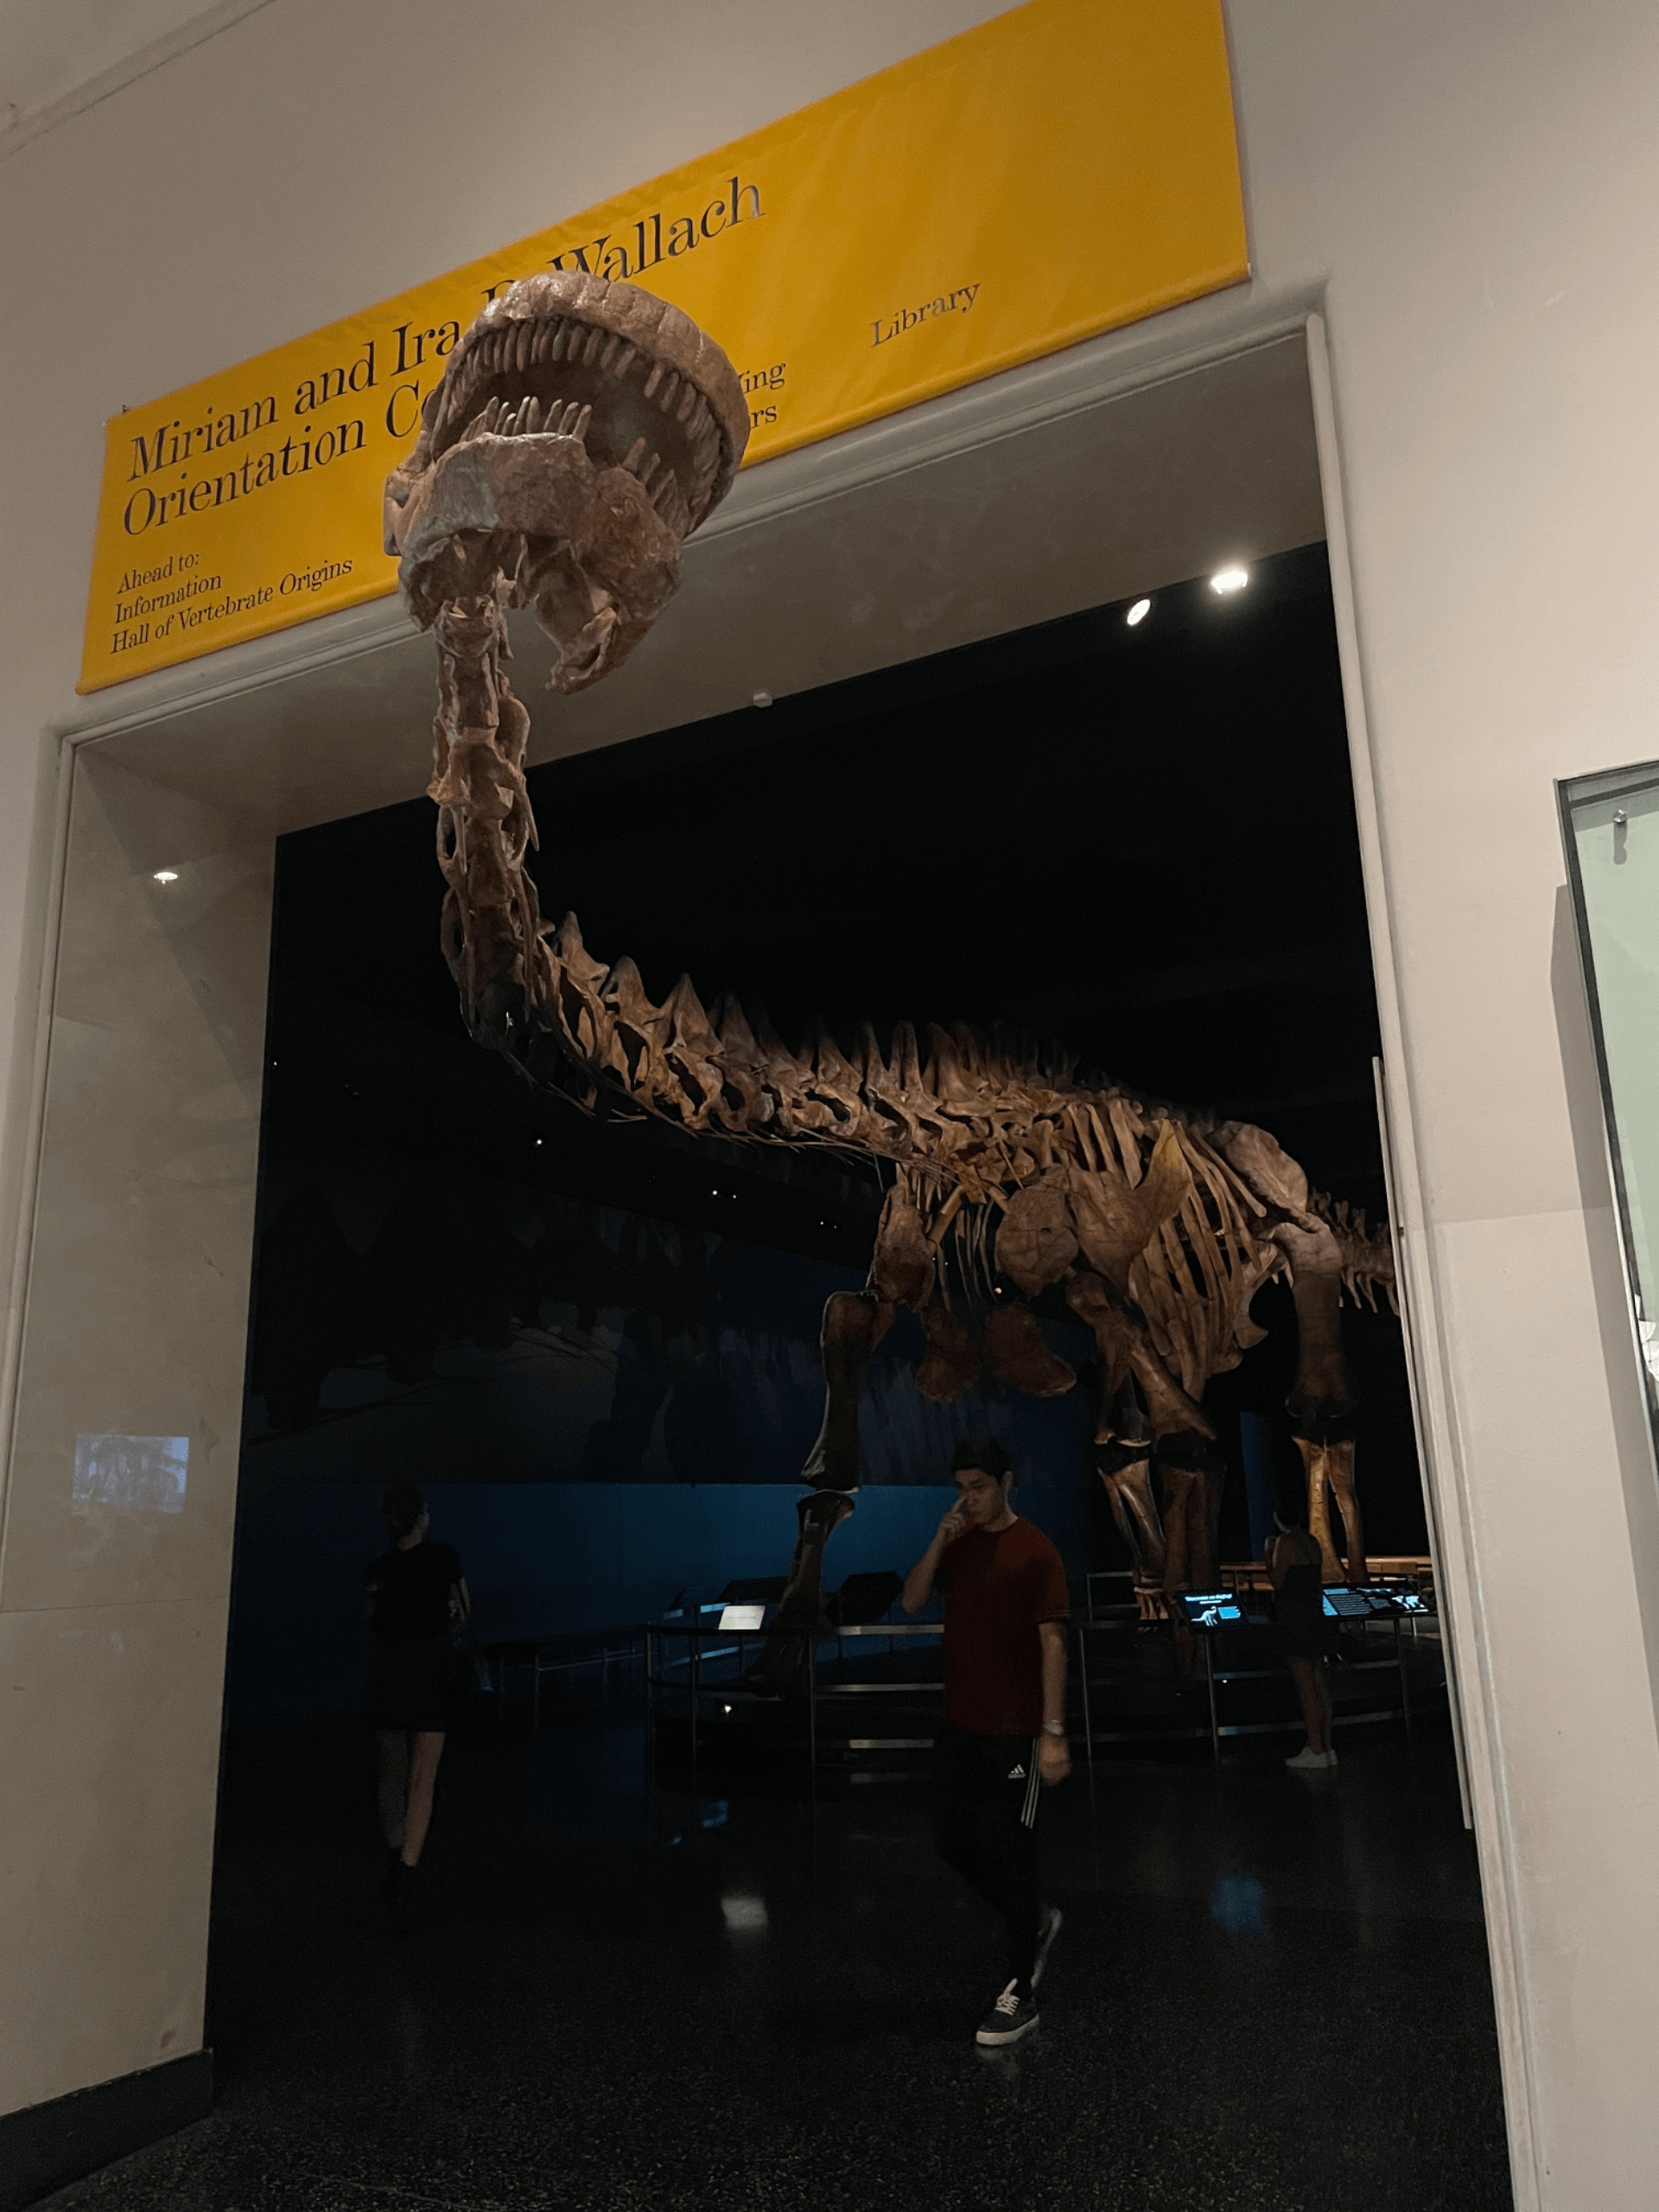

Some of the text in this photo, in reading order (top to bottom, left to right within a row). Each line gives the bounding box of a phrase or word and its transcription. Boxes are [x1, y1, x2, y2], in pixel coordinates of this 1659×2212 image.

[870, 283, 982, 347] Library
[127, 396, 278, 482] Miriam
[295, 340, 378, 415] and
[390, 321, 460, 377] Ira
[124, 420, 367, 536] Orientation
[110, 560, 353, 655] Hall of Vertebrate Origins
[115, 575, 222, 624] Information
[117, 553, 199, 594] Ahead to:
